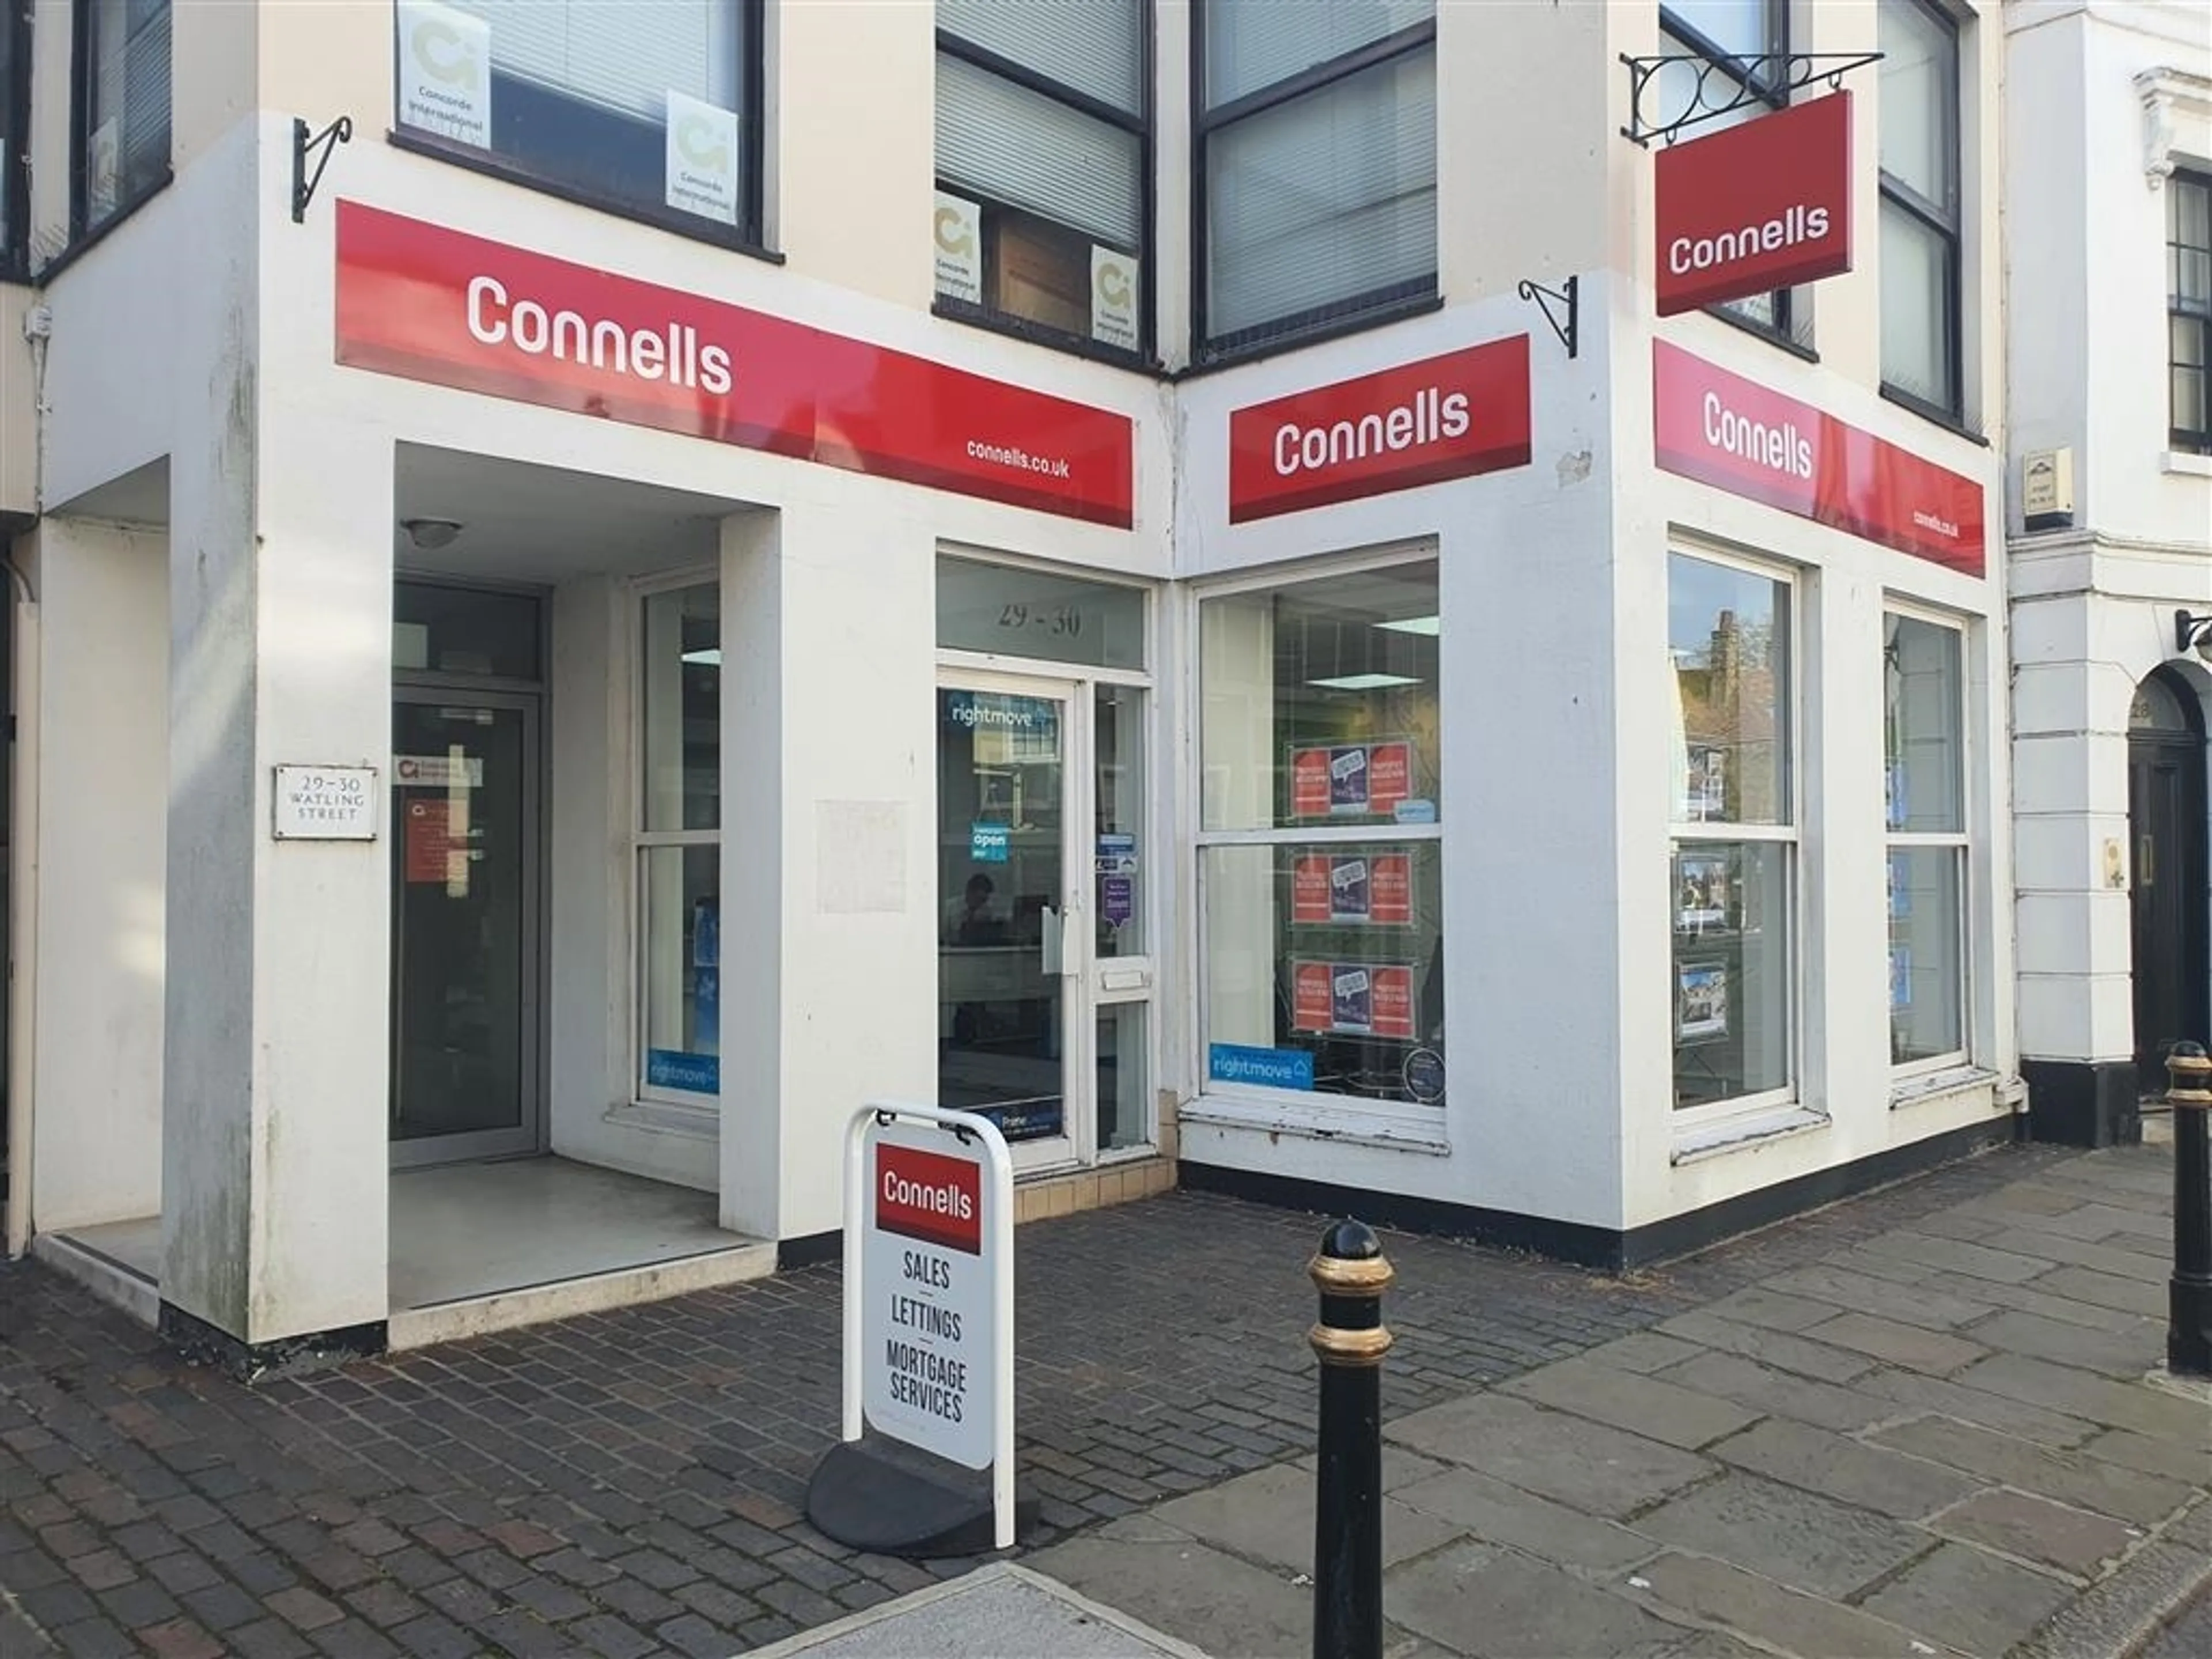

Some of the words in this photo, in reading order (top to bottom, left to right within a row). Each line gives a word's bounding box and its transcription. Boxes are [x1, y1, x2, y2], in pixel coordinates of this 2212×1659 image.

[419, 86, 472, 111] Concorde
[1670, 205, 1829, 275] Connells
[467, 275, 732, 395] Connells
[1275, 387, 1470, 476] Connells
[1703, 391, 1813, 479] Connells
[967, 440, 1070, 478] connells.co.uk
[952, 703, 1032, 727] rightmove
[290, 793, 365, 807] WATLING
[298, 808, 357, 820] STREET
[974, 834, 1006, 847] open
[1213, 1055, 1293, 1079] rightmove
[884, 1171, 972, 1219] Connells
[903, 1251, 950, 1289] SALES
[892, 1294, 961, 1342] LETTINGS
[886, 1339, 967, 1393] MORTGAGE
[889, 1371, 963, 1423] SERVICES
